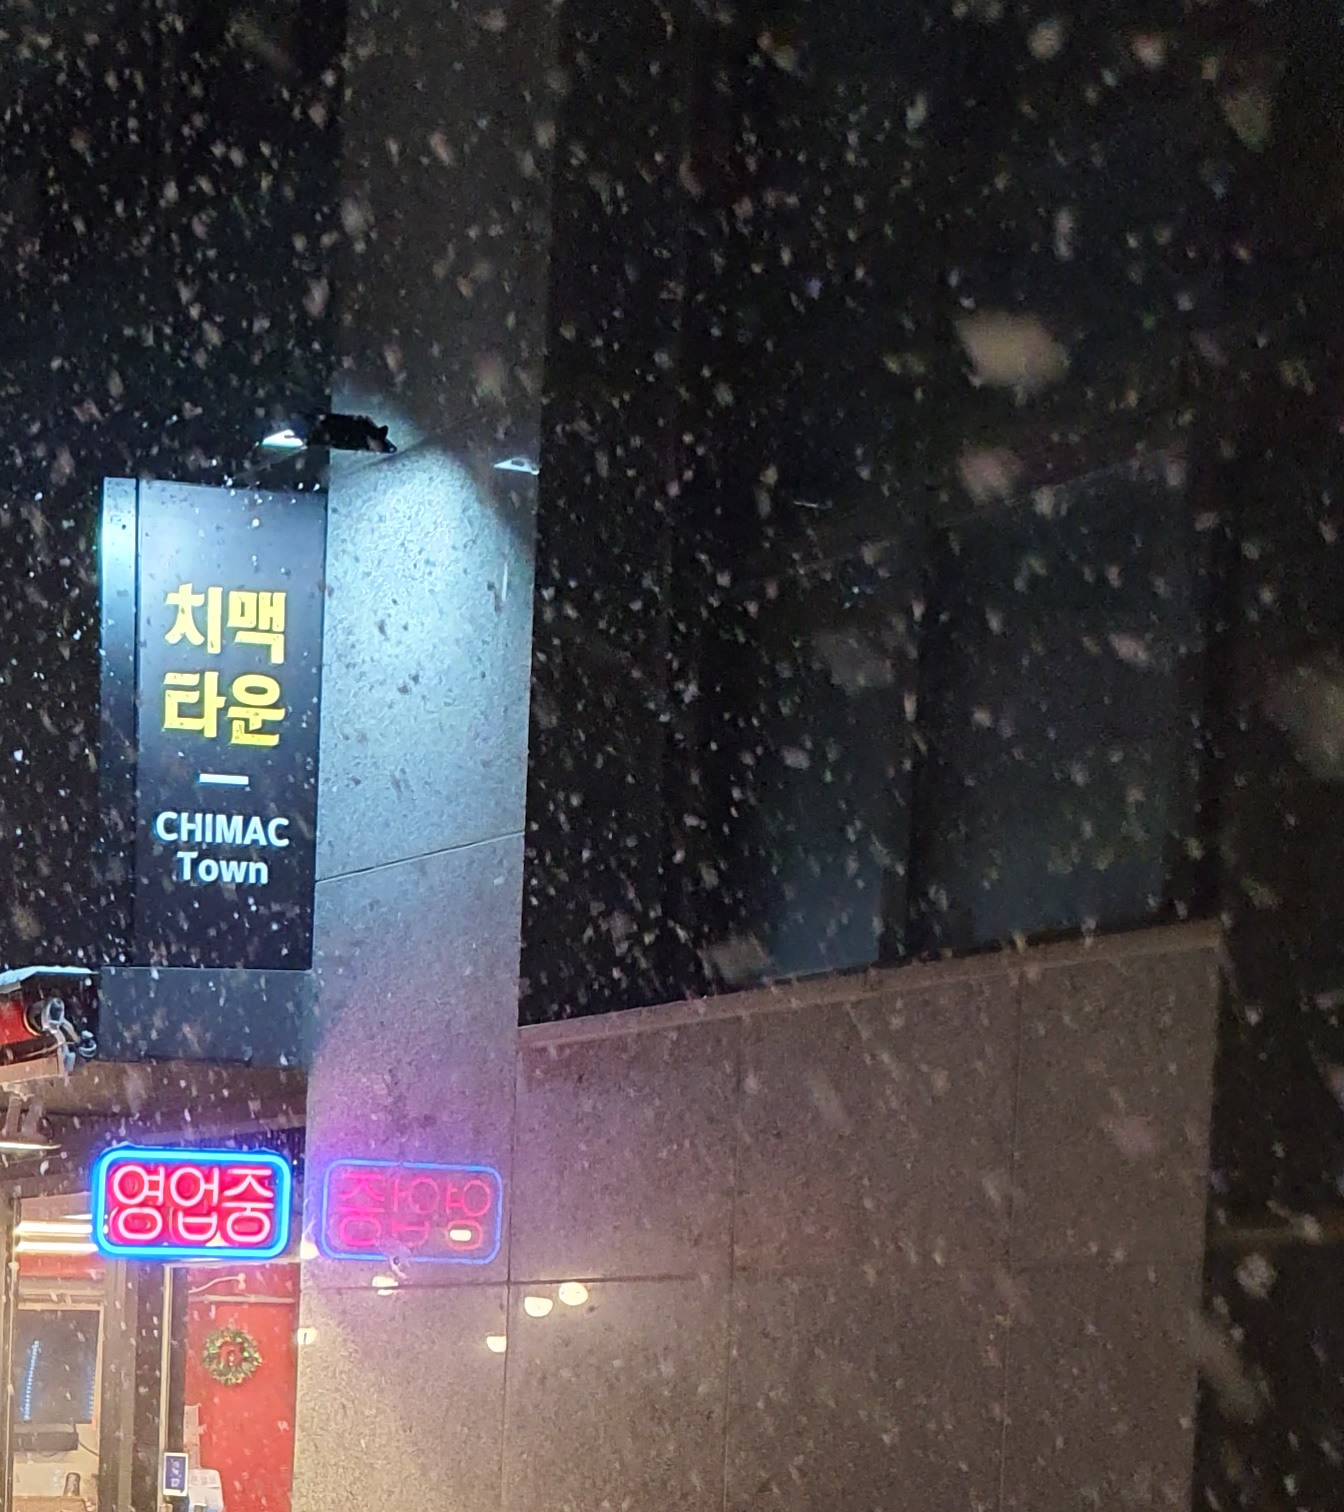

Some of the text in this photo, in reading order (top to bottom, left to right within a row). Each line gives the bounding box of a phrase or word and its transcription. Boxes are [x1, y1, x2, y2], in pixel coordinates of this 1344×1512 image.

[164, 583, 287, 665] 치맥
[162, 671, 287, 747] 타운
[155, 811, 290, 848] CHIMAC
[176, 851, 269, 884] Town
[112, 1163, 276, 1246] 영업중
